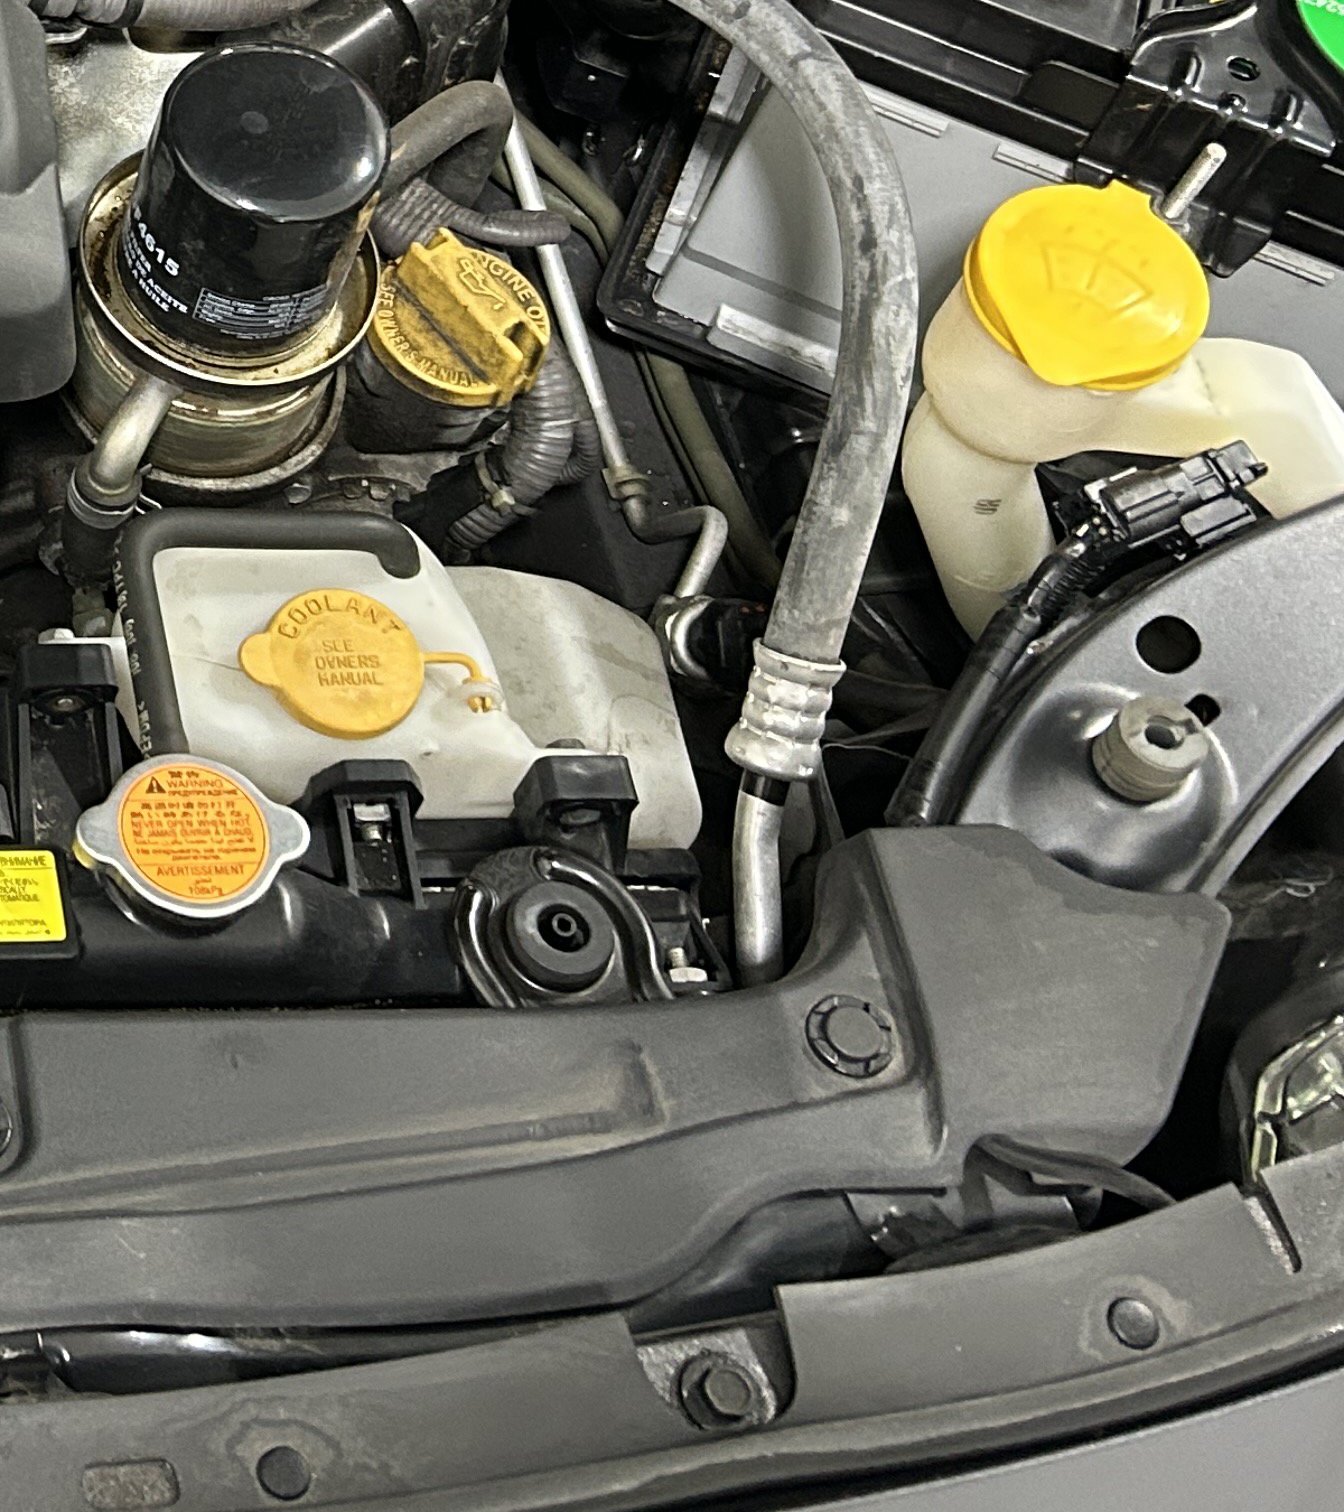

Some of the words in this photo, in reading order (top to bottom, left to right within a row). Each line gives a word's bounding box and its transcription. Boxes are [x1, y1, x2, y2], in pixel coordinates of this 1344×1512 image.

[472, 252, 532, 303] NGINE
[380, 283, 396, 308] SEE
[278, 594, 402, 639] COOLANT
[322, 640, 354, 653] SEE
[318, 671, 384, 686] MANUAL
[156, 864, 244, 877] AVERTISSEMENT
